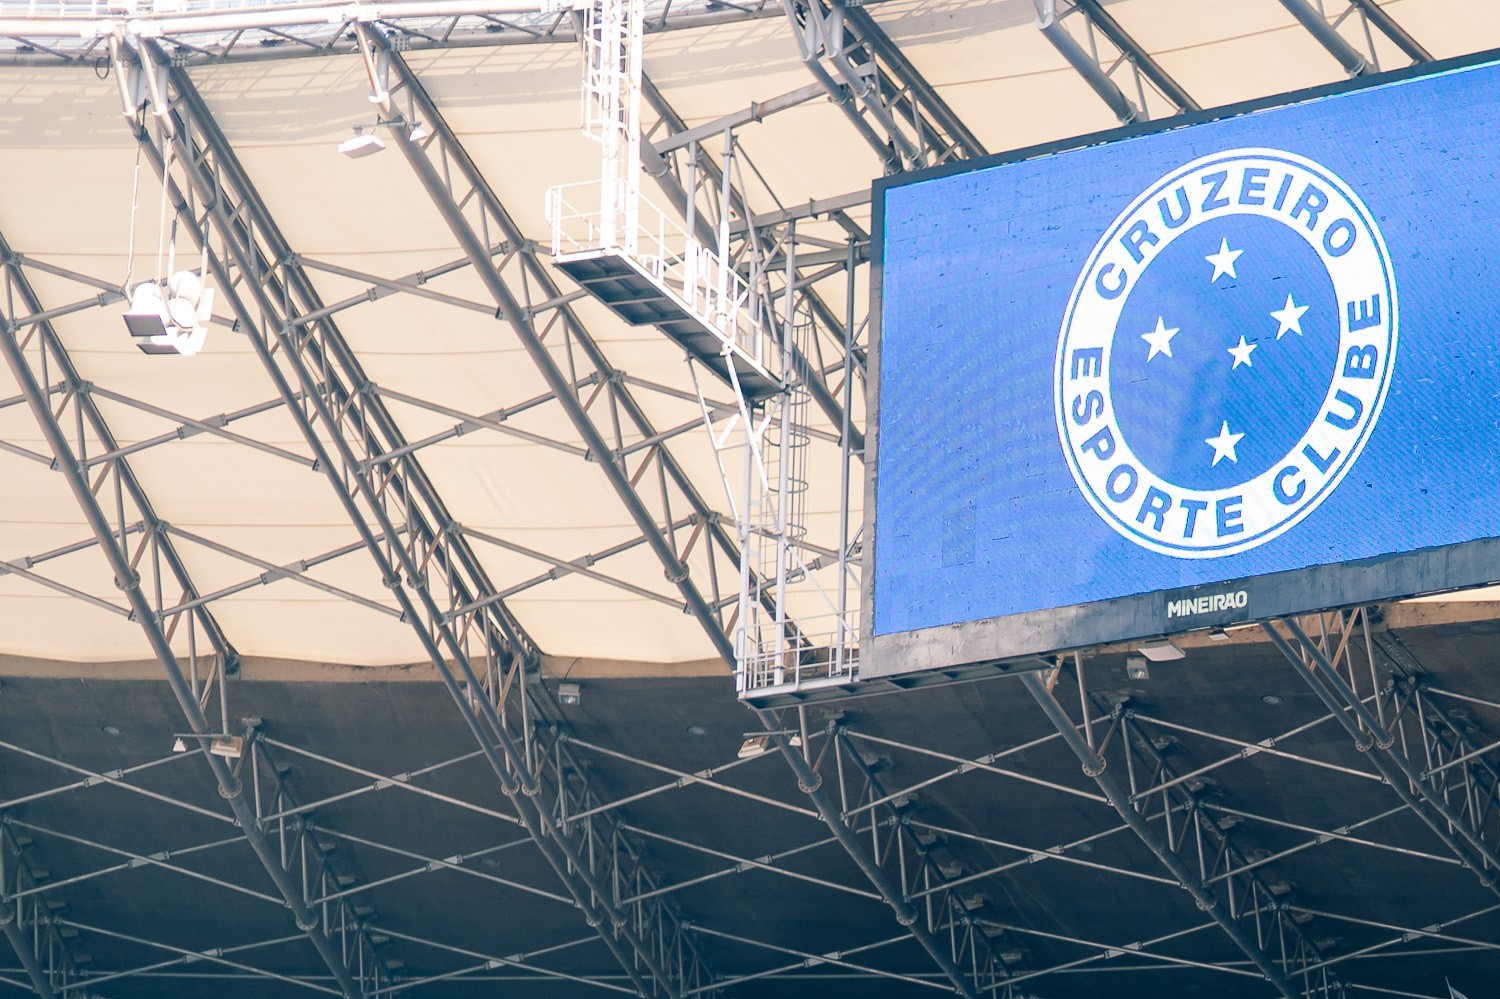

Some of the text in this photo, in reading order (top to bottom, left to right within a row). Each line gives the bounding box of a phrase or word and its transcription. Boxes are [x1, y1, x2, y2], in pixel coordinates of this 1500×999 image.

[1095, 167, 1357, 301] CRUZEIRO
[1070, 294, 1382, 539] ESPORTE CLUBE
